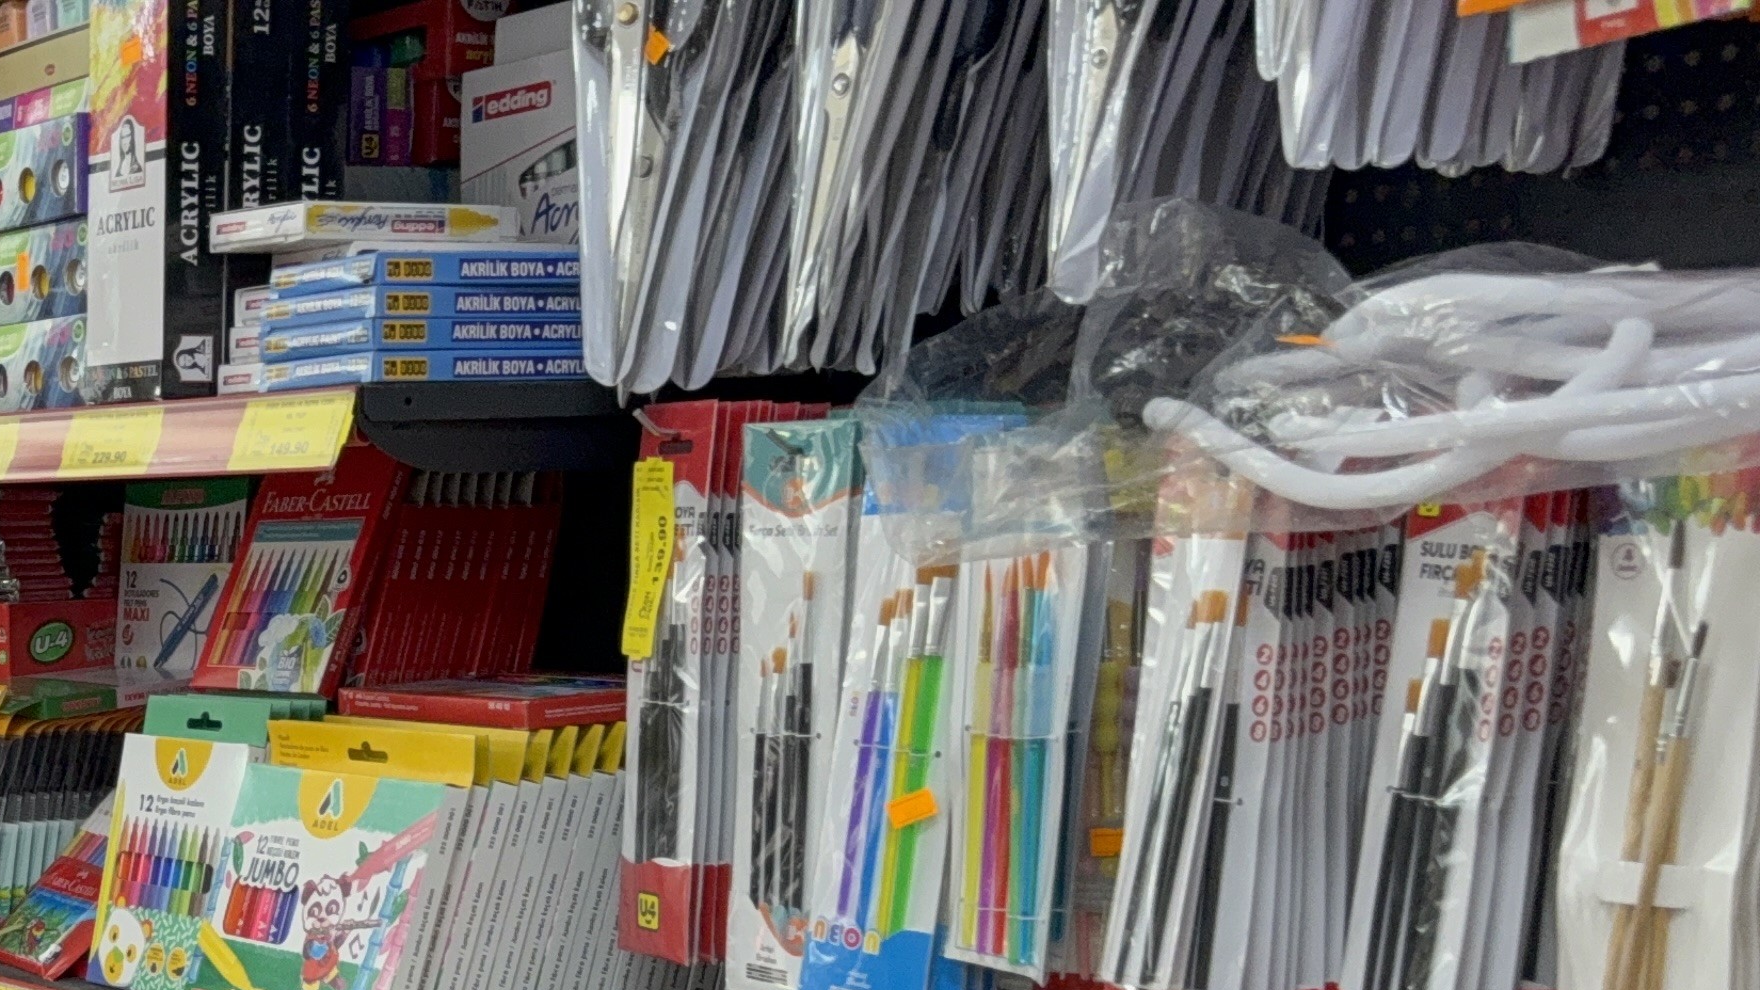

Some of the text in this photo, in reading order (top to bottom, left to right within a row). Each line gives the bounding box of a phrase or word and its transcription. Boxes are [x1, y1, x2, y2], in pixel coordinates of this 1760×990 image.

[487, 87, 548, 117] edding
[97, 207, 156, 236] ACRYLIC
[510, 259, 544, 277] BOYA
[503, 294, 535, 312] BOYA
[498, 323, 531, 341] BOYA
[502, 357, 535, 376] BOYA
